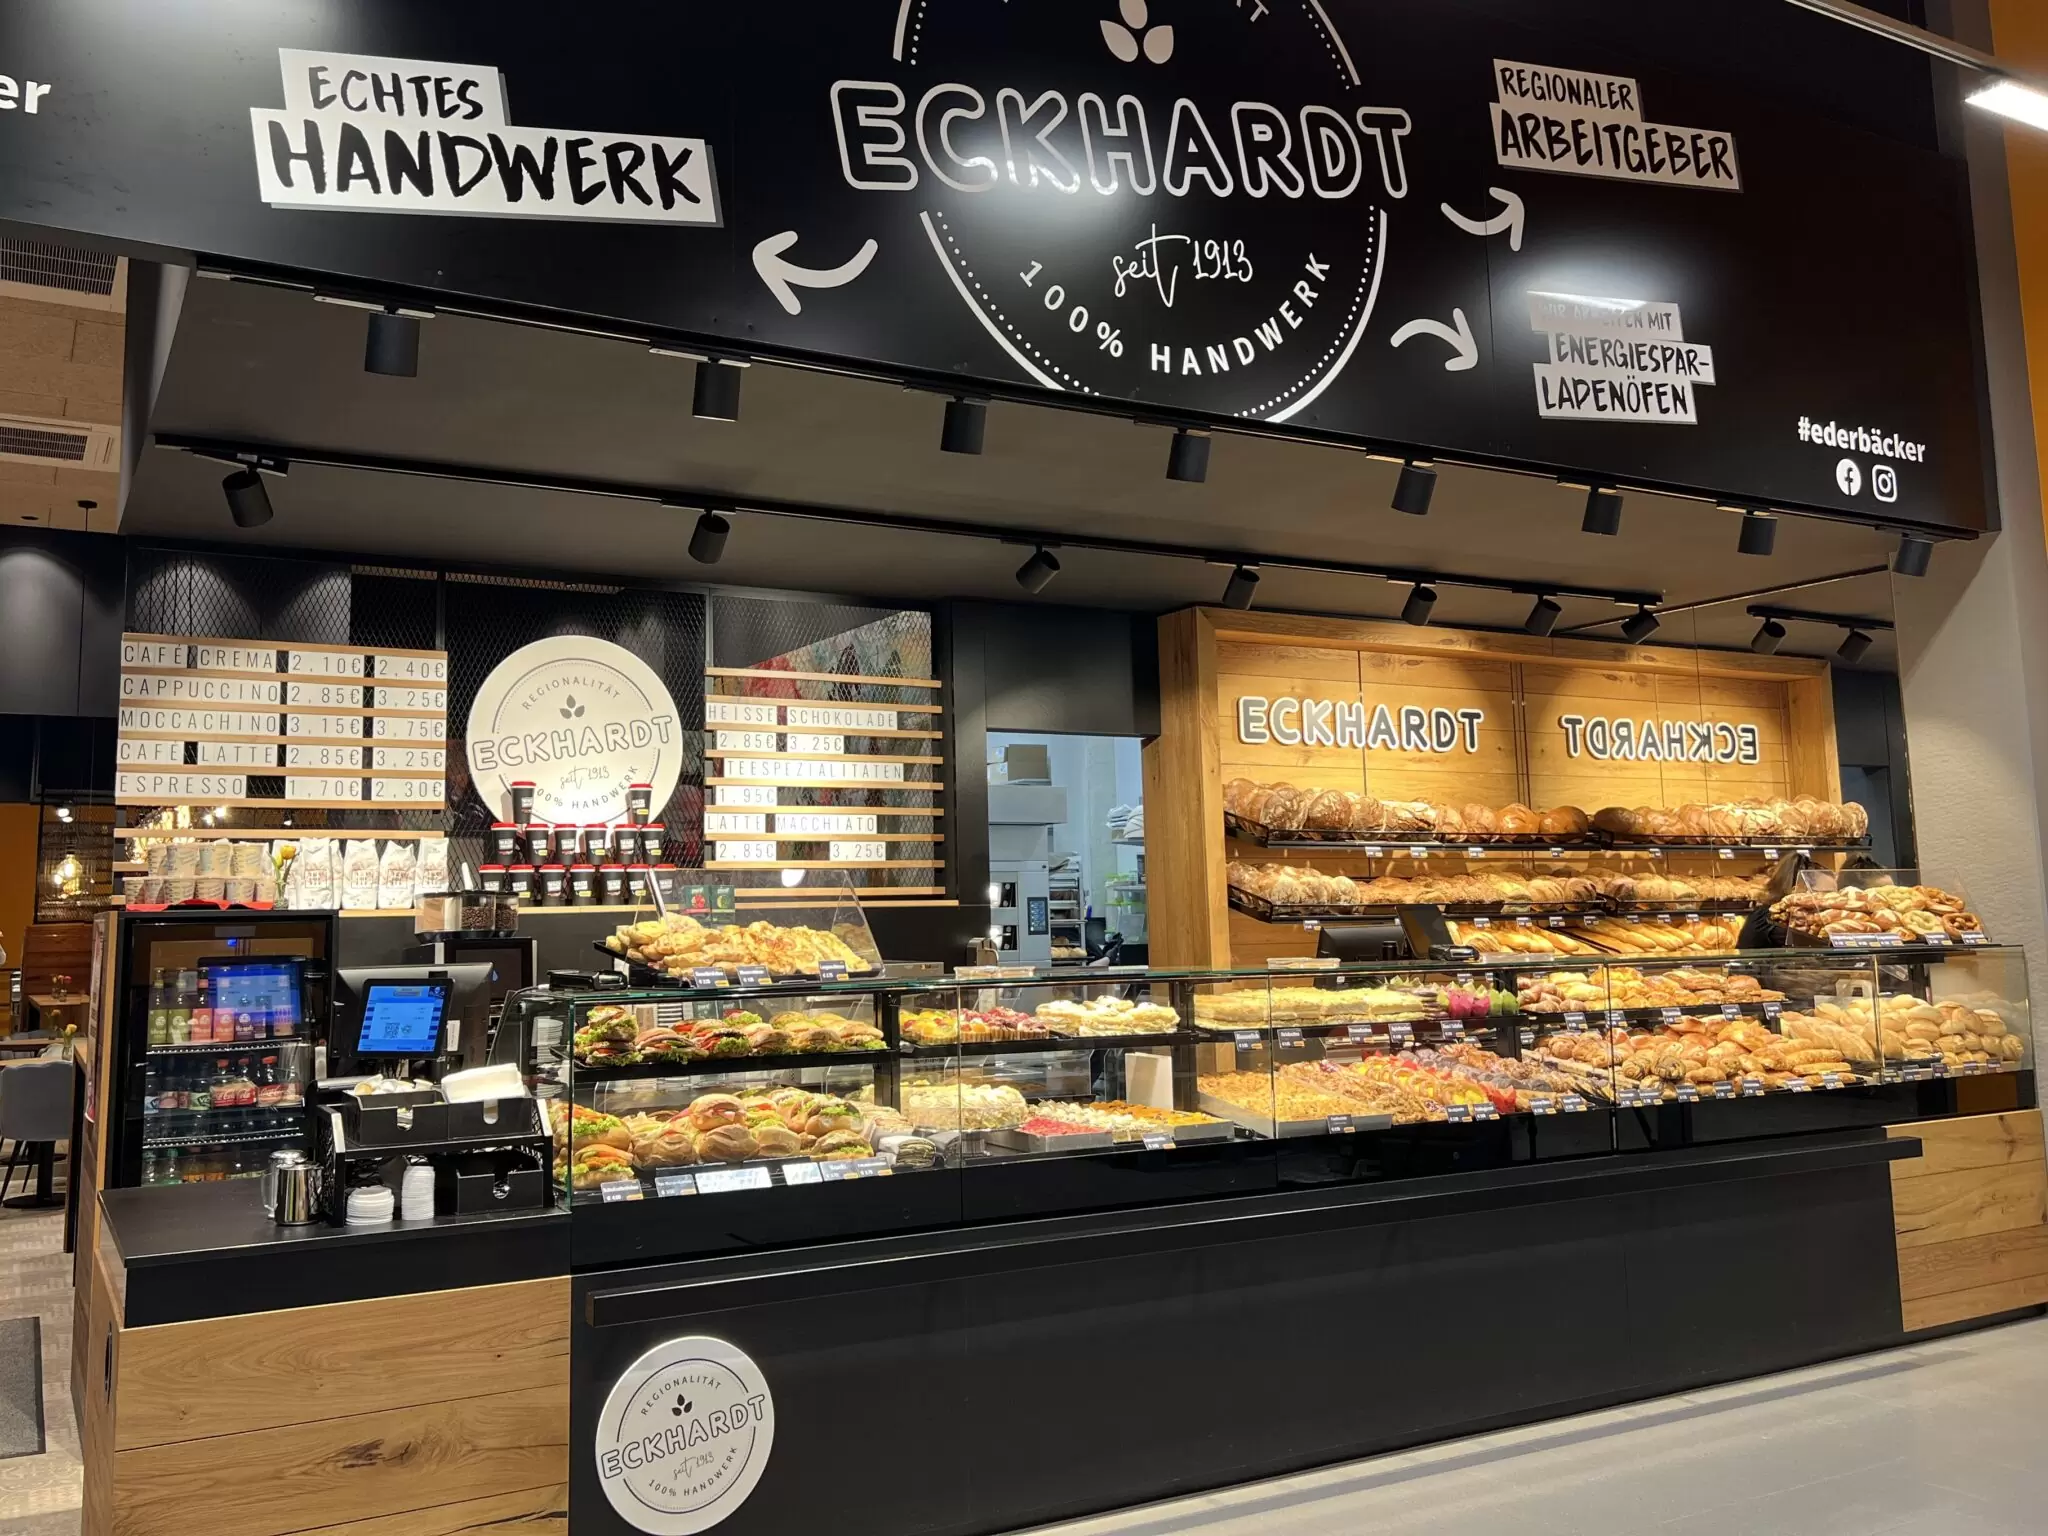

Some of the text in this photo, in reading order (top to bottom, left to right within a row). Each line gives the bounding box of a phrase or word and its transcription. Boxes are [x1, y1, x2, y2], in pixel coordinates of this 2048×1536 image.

[307, 65, 484, 120] ECHTES
[1500, 67, 1634, 111] REGIONALER
[830, 80, 1412, 198] ECKHARDT
[1501, 109, 1734, 180] ARBEITGEBER
[267, 119, 702, 210] HANDWERK
[1113, 223, 1253, 307] seit 1913
[1019, 252, 1331, 375] 100% HANDWERK
[1648, 312, 1672, 331] MIT
[1555, 332, 1710, 377] ENERGIESPAR-
[1541, 374, 1688, 415] LADENÖFEN
[1798, 416, 1926, 463] #ederbäcker
[124, 643, 181, 664] CAFÉ
[200, 649, 273, 669] CREMA
[123, 678, 278, 702] CAPPUCCINO
[522, 676, 620, 710] REGIONALITÄT
[121, 710, 276, 732] MOCCACHINO
[708, 705, 895, 728] HEISSE SCHOKOLADE
[1237, 695, 1484, 753] ECKHARDT
[120, 740, 179, 761] CAFÉ
[201, 746, 272, 763] LATTE
[472, 715, 673, 772] ECKHARDT
[120, 775, 242, 795] ESPRESSO
[536, 766, 638, 809] 00% HANDWERK
[588, 765, 610, 780] 1913
[708, 815, 874, 832] LATTE MACCHIATO
[640, 1375, 722, 1416] REGIONALITÄT
[601, 1394, 765, 1480] ECKHARDT
[649, 1446, 738, 1497] 100% HANDWERK
[696, 1451, 715, 1467] 1913
